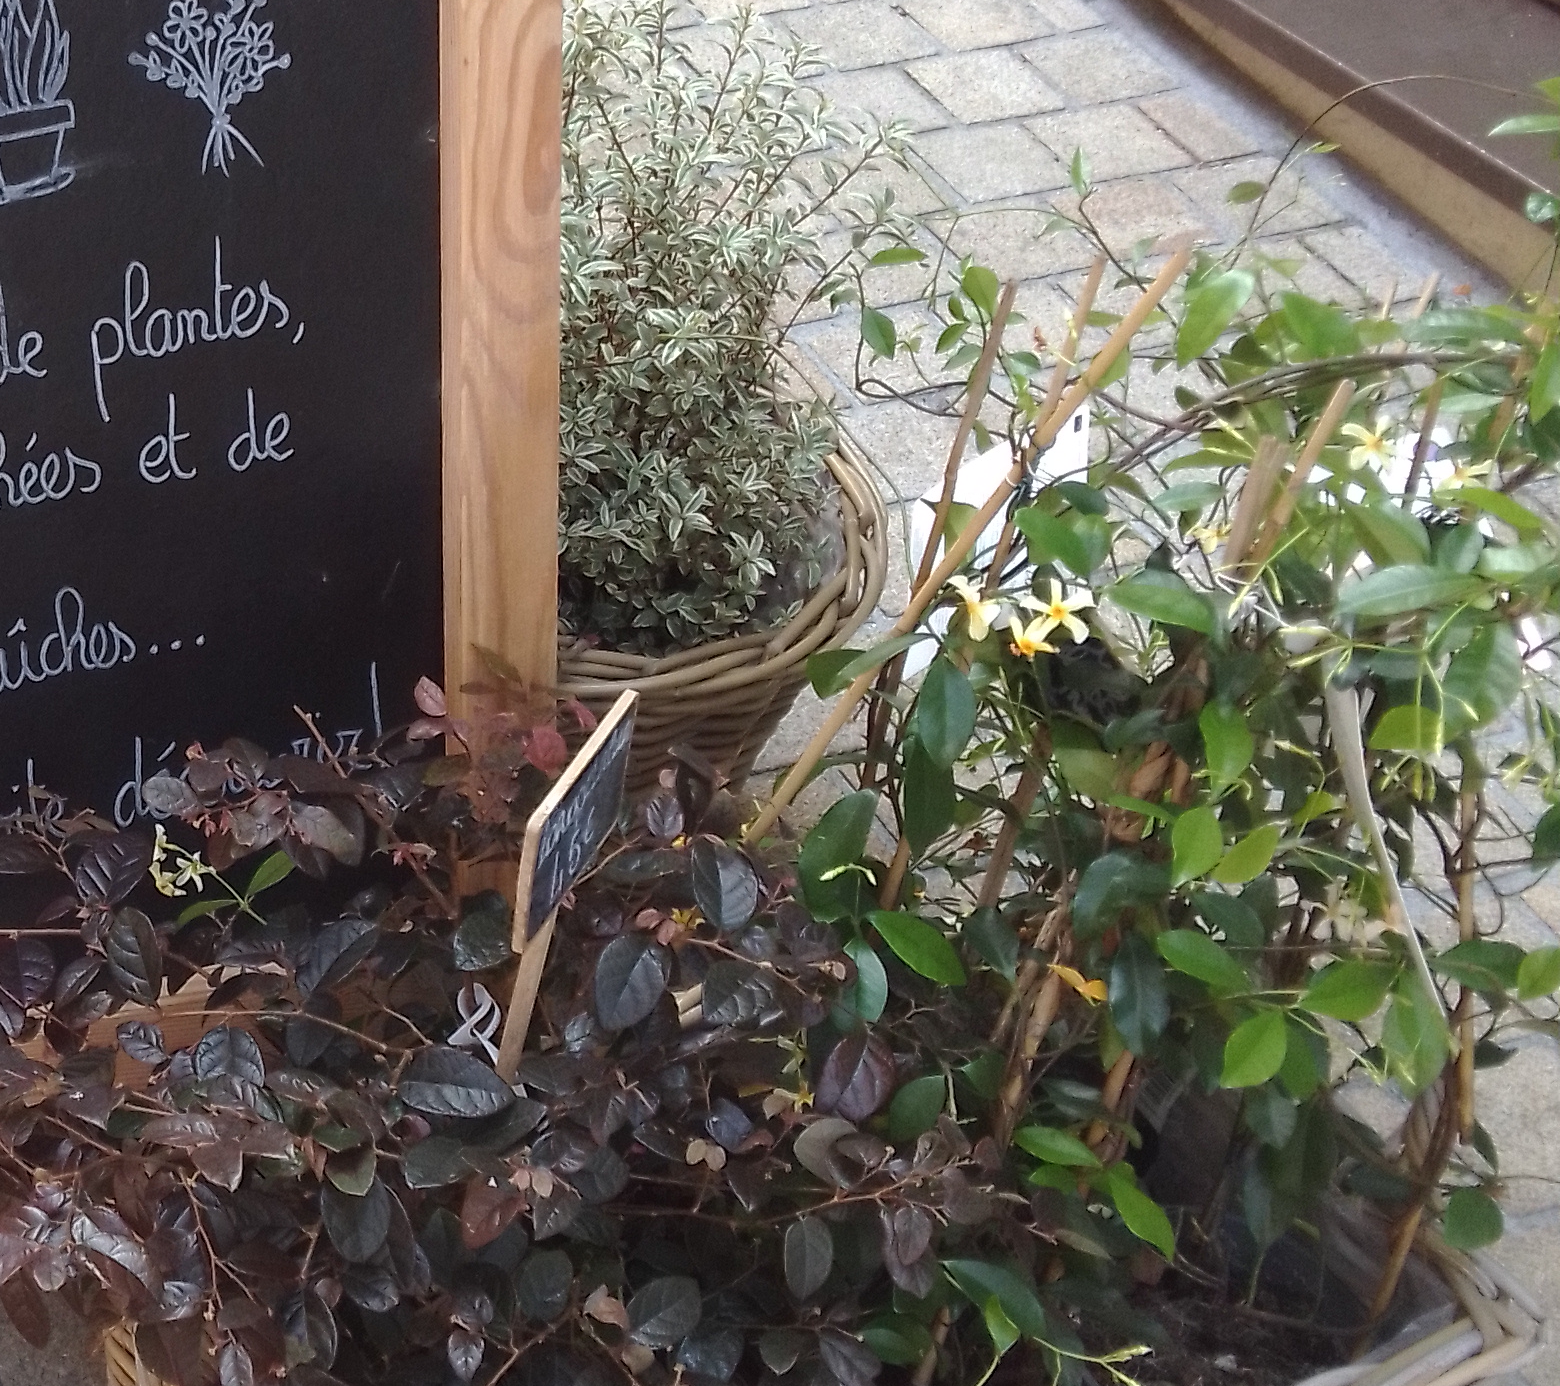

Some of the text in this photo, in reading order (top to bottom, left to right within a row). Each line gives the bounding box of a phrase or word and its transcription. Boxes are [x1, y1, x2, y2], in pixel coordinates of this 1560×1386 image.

[91, 236, 305, 422] plantes,
[138, 393, 196, 483] et
[228, 388, 294, 471] de
